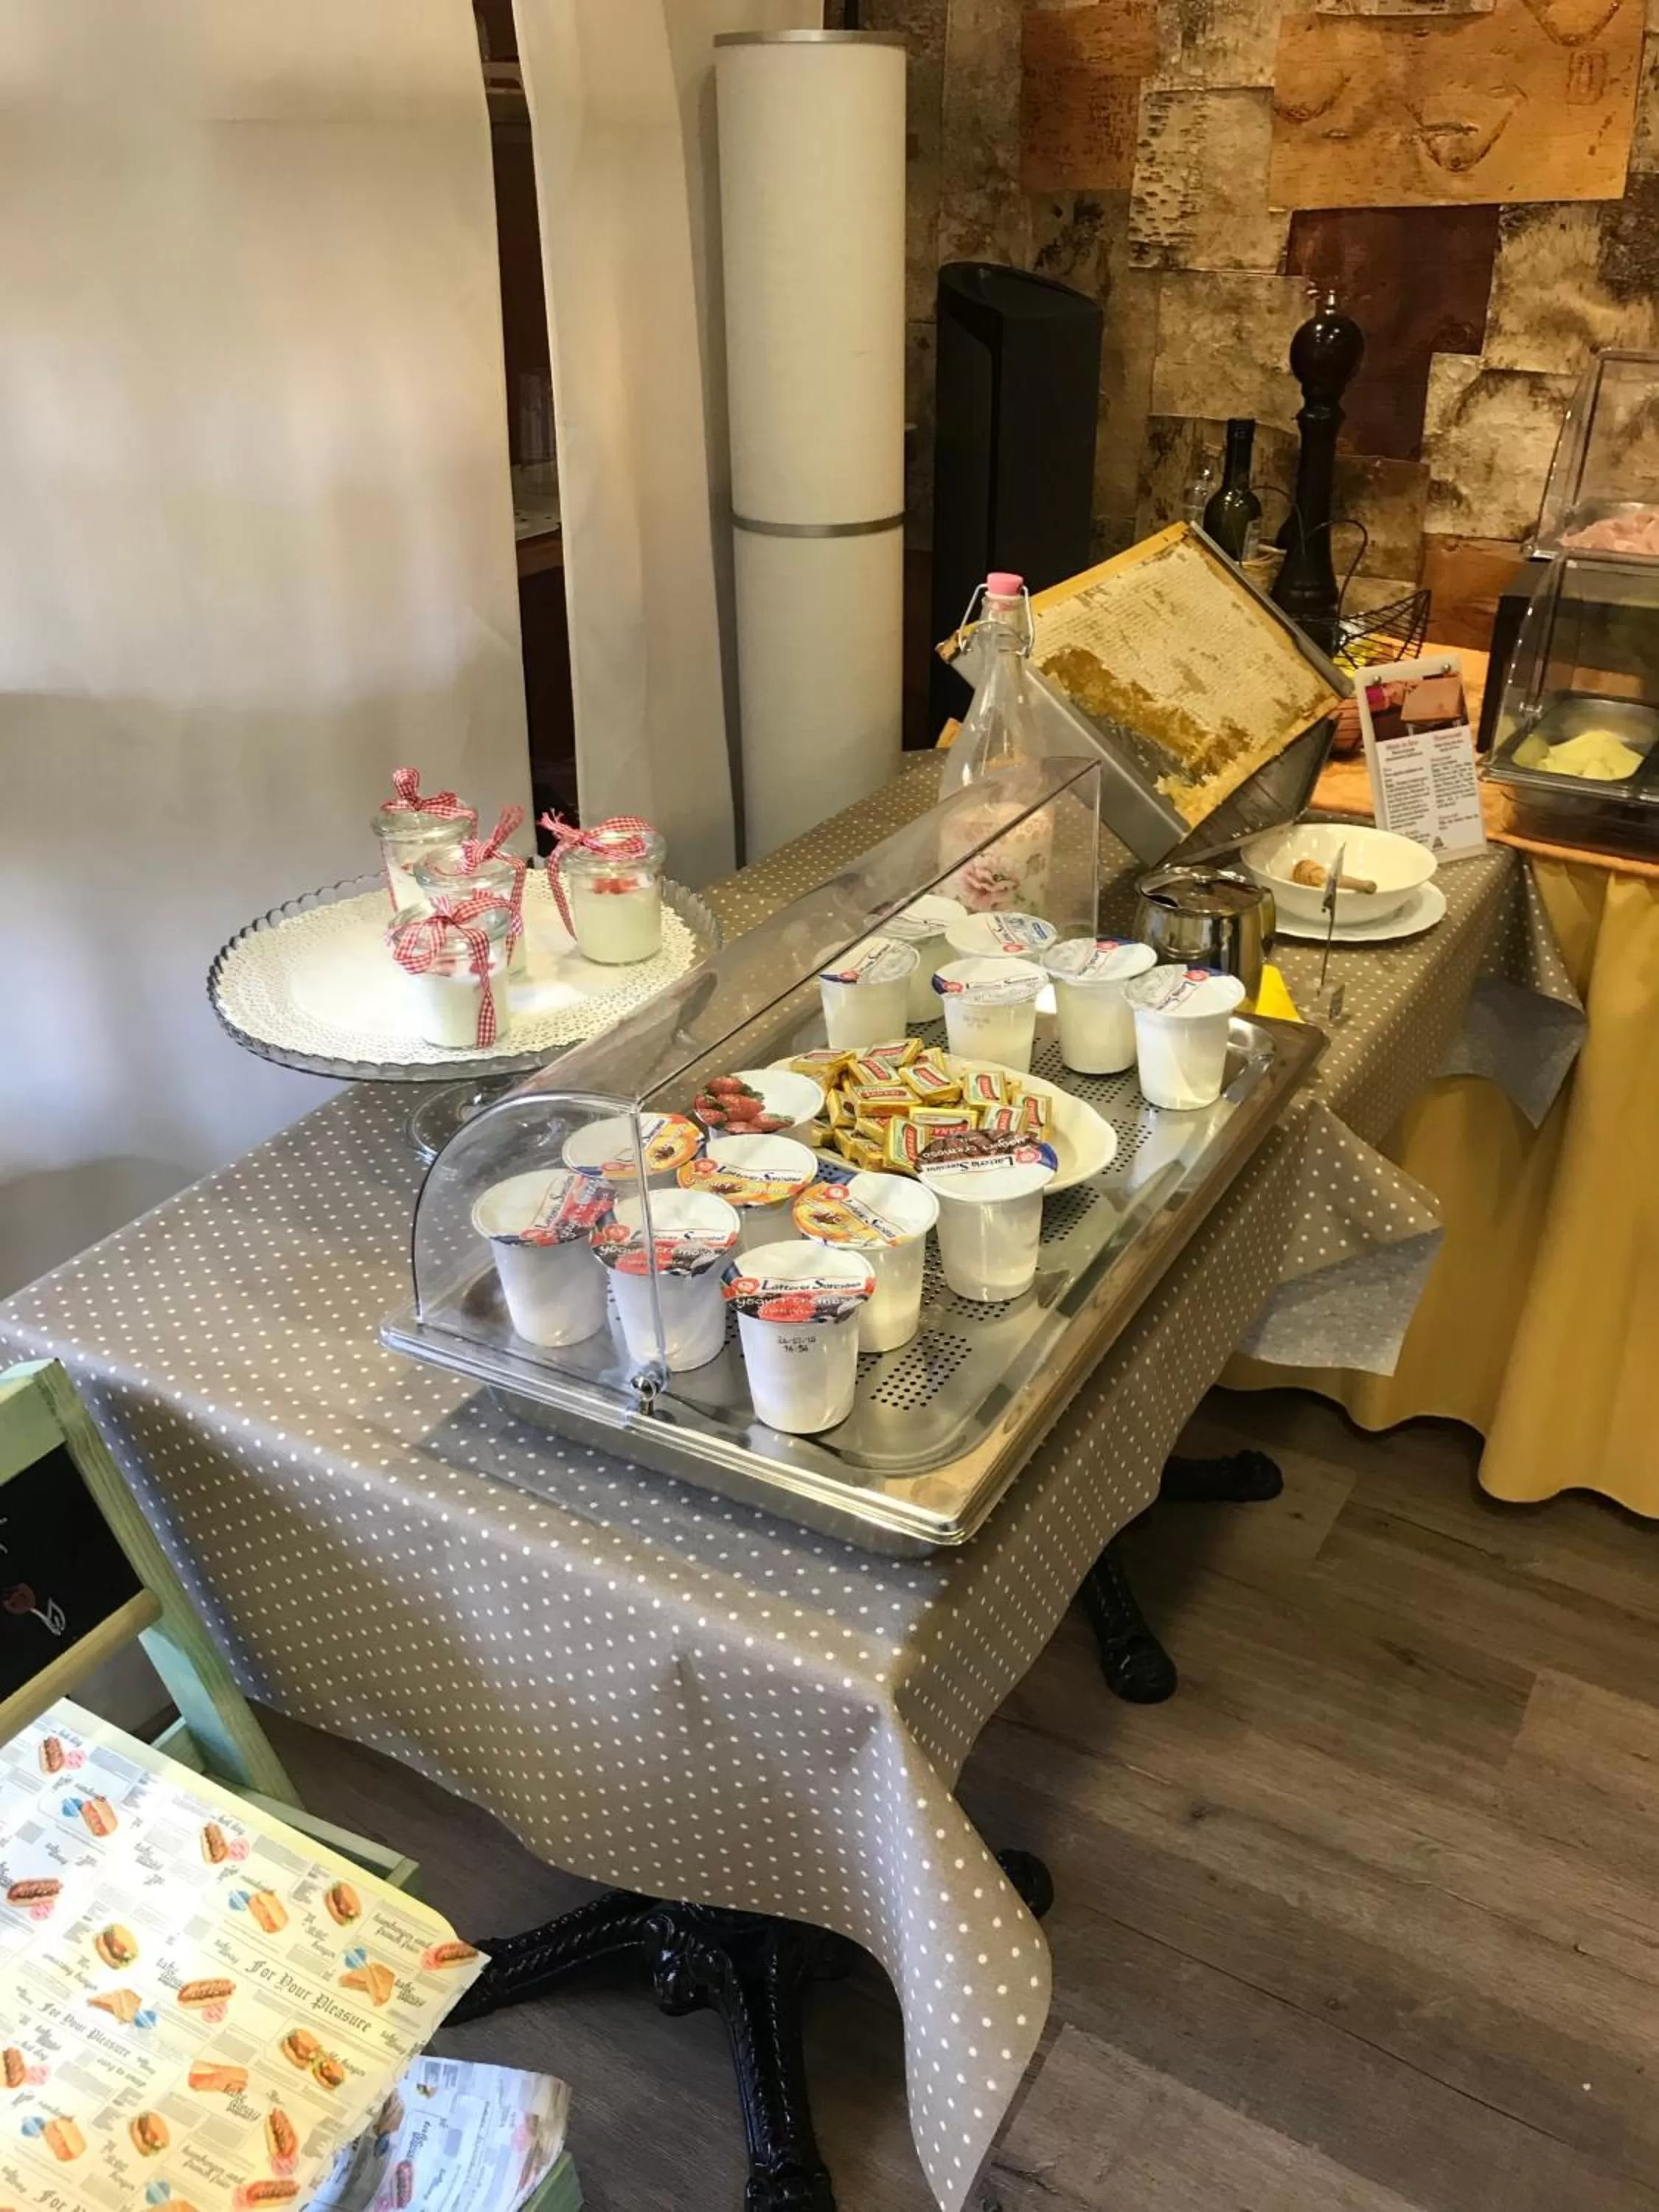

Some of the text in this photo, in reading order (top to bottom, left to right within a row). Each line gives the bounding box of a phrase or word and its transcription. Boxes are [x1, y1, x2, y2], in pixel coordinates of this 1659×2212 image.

[245, 1961, 372, 2032] For Your Pleasure
[32, 2190, 67, 2211] For
